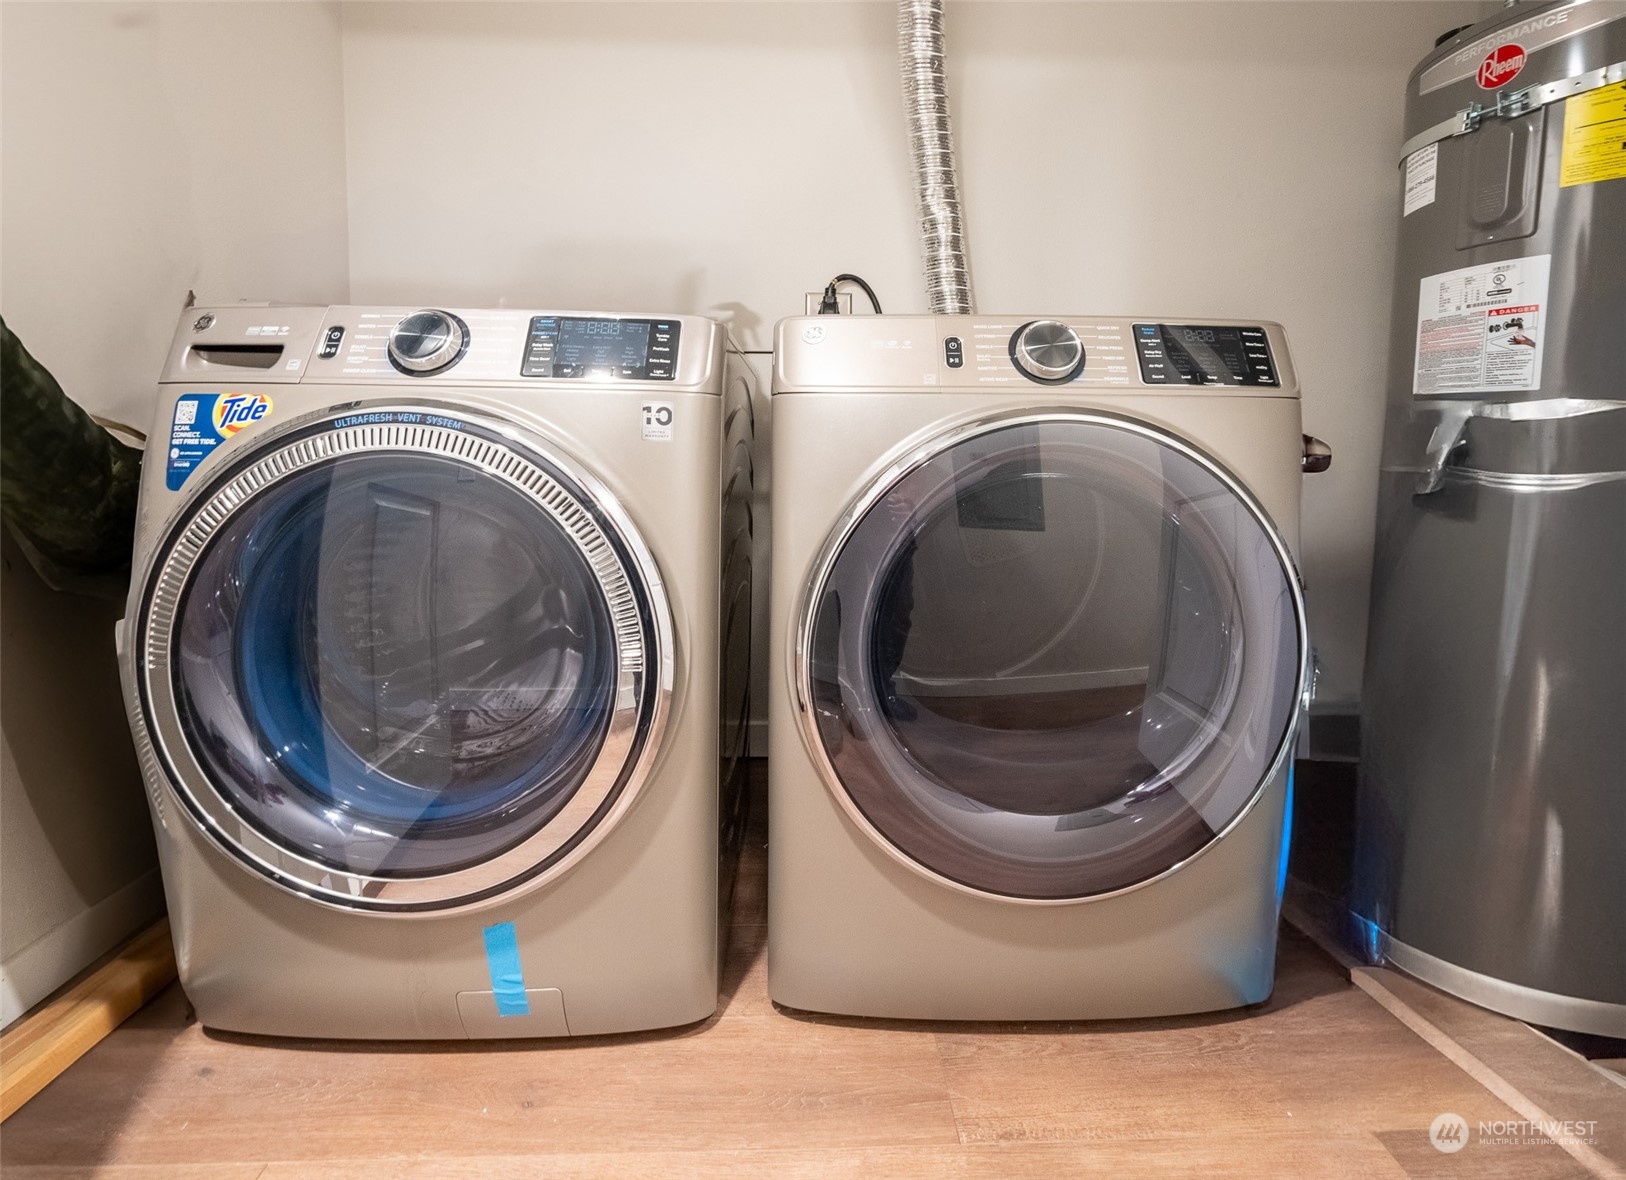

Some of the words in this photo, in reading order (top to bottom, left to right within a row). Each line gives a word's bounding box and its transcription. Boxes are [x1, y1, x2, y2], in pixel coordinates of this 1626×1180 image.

[1454, 12, 1569, 66] PERFORMANCE
[1481, 48, 1523, 86] Rheem
[1500, 306, 1536, 315] DANGER
[220, 397, 268, 428] Tide
[334, 413, 392, 428] ULTRAFRESH
[396, 413, 421, 423] VENT
[426, 416, 462, 430] SYSTEM
[642, 406, 672, 426] 10
